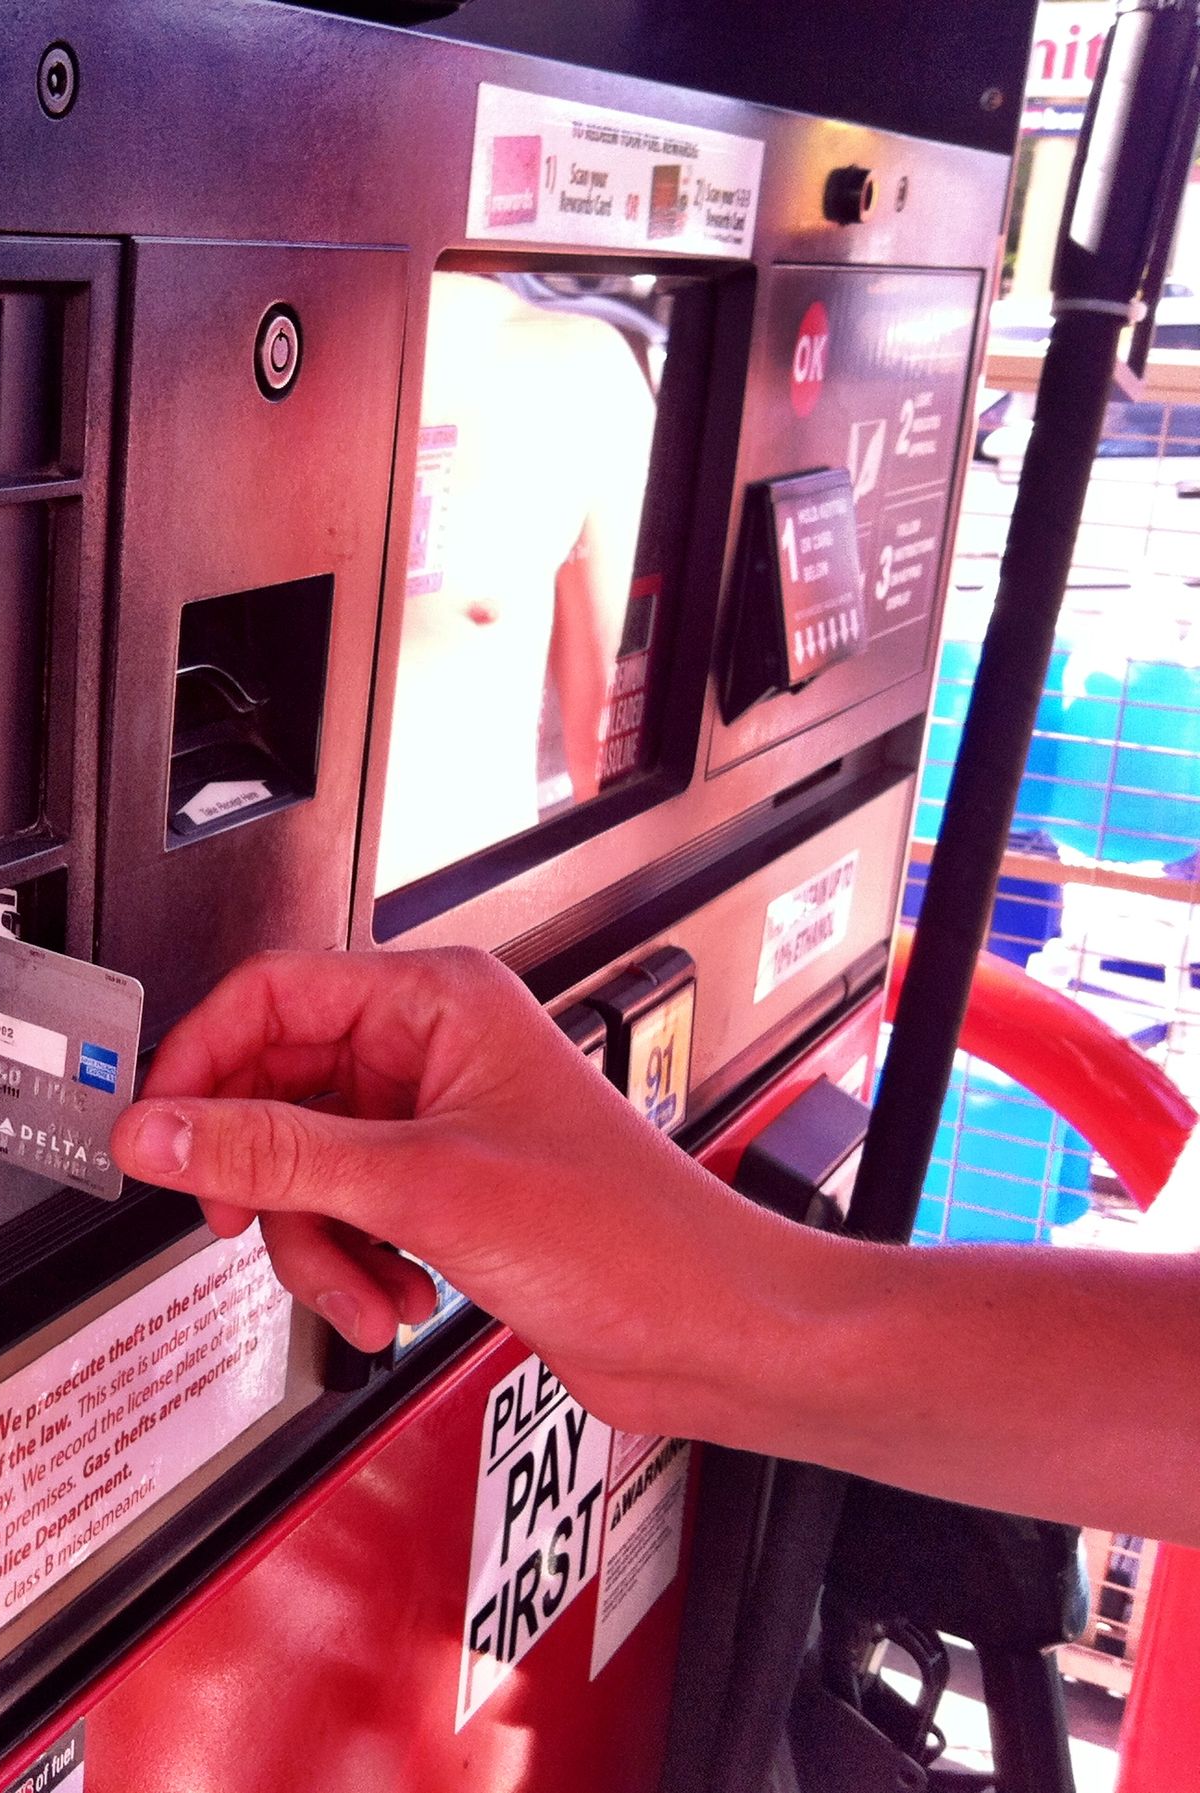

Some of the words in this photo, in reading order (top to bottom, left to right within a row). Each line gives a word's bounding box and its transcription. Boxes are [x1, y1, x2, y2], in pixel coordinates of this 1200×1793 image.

[792, 332, 828, 384] OK
[894, 399, 915, 456] 2
[875, 544, 894, 601] 3
[646, 1038, 675, 1101] 91
[20, 1124, 88, 1162] DELTA
[25, 1354, 106, 1429] prosecute
[108, 1322, 146, 1364] theft
[148, 1314, 164, 1336] to
[166, 1295, 190, 1324] the
[192, 1263, 234, 1305] fullest
[236, 1244, 267, 1273] exte
[4, 1475, 78, 1546] premises.
[82, 1447, 111, 1479] Gas
[113, 1412, 157, 1456] thefts
[159, 1396, 182, 1423] are
[184, 1341, 243, 1411] reported
[244, 1335, 259, 1356] to
[8, 1438, 37, 1470] the
[40, 1413, 73, 1446] law.
[77, 1385, 107, 1418] This
[109, 1366, 135, 1396] site
[137, 1355, 149, 1376] is
[151, 1325, 191, 1366] under
[22, 1463, 46, 1492] We
[49, 1418, 98, 1473] record
[100, 1405, 125, 1435] the
[127, 1369, 174, 1415] license
[175, 1342, 209, 1384] plate
[210, 1330, 224, 1353] of
[489, 1360, 569, 1459] PLE
[34, 1462, 133, 1548] Department.
[501, 1406, 588, 1567] PAY
[3, 1567, 41, 1609] class
[44, 1554, 54, 1578] B
[57, 1477, 156, 1567] misdemeanor.
[464, 1480, 603, 1713] FIRST
[34, 1763, 50, 1793] of
[52, 1739, 76, 1779] fuel
